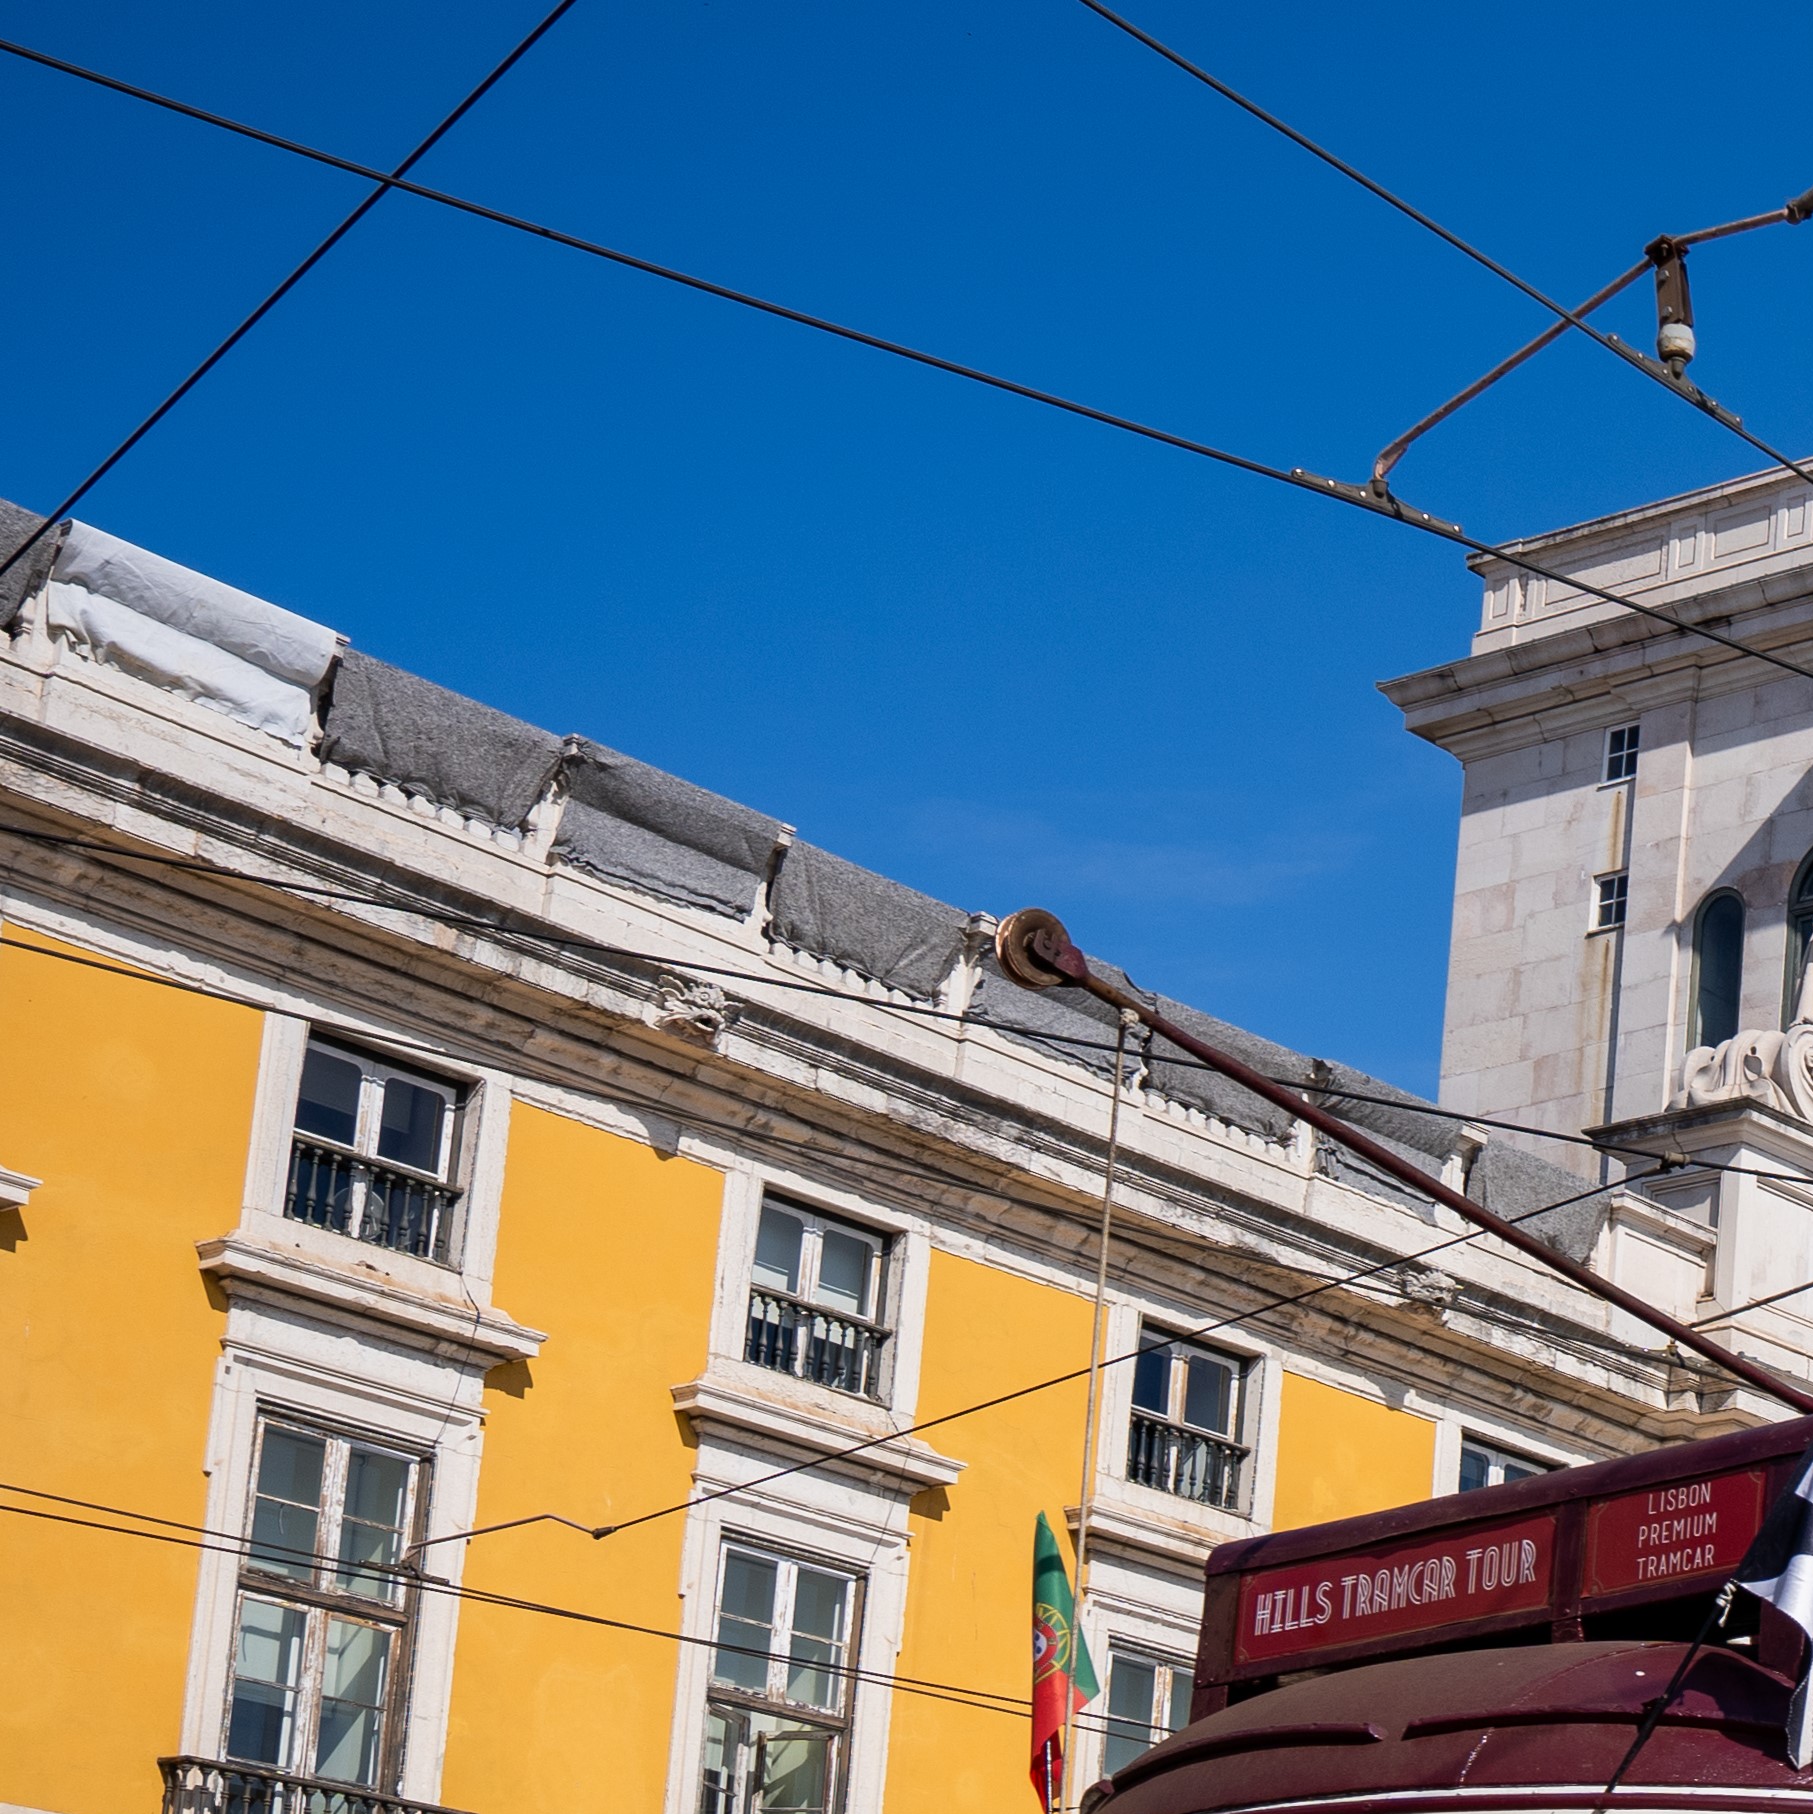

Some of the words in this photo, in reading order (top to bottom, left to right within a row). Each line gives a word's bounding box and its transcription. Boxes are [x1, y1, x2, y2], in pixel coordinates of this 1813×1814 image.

[1647, 1482, 1712, 1515] LISBON
[1637, 1513, 1718, 1549] PREMIUM
[1636, 1544, 1715, 1581] TRAMCAR
[1254, 1580, 1332, 1636] HILLS
[1341, 1556, 1457, 1621] TRAMCAR
[1465, 1538, 1538, 1594] TOUR
